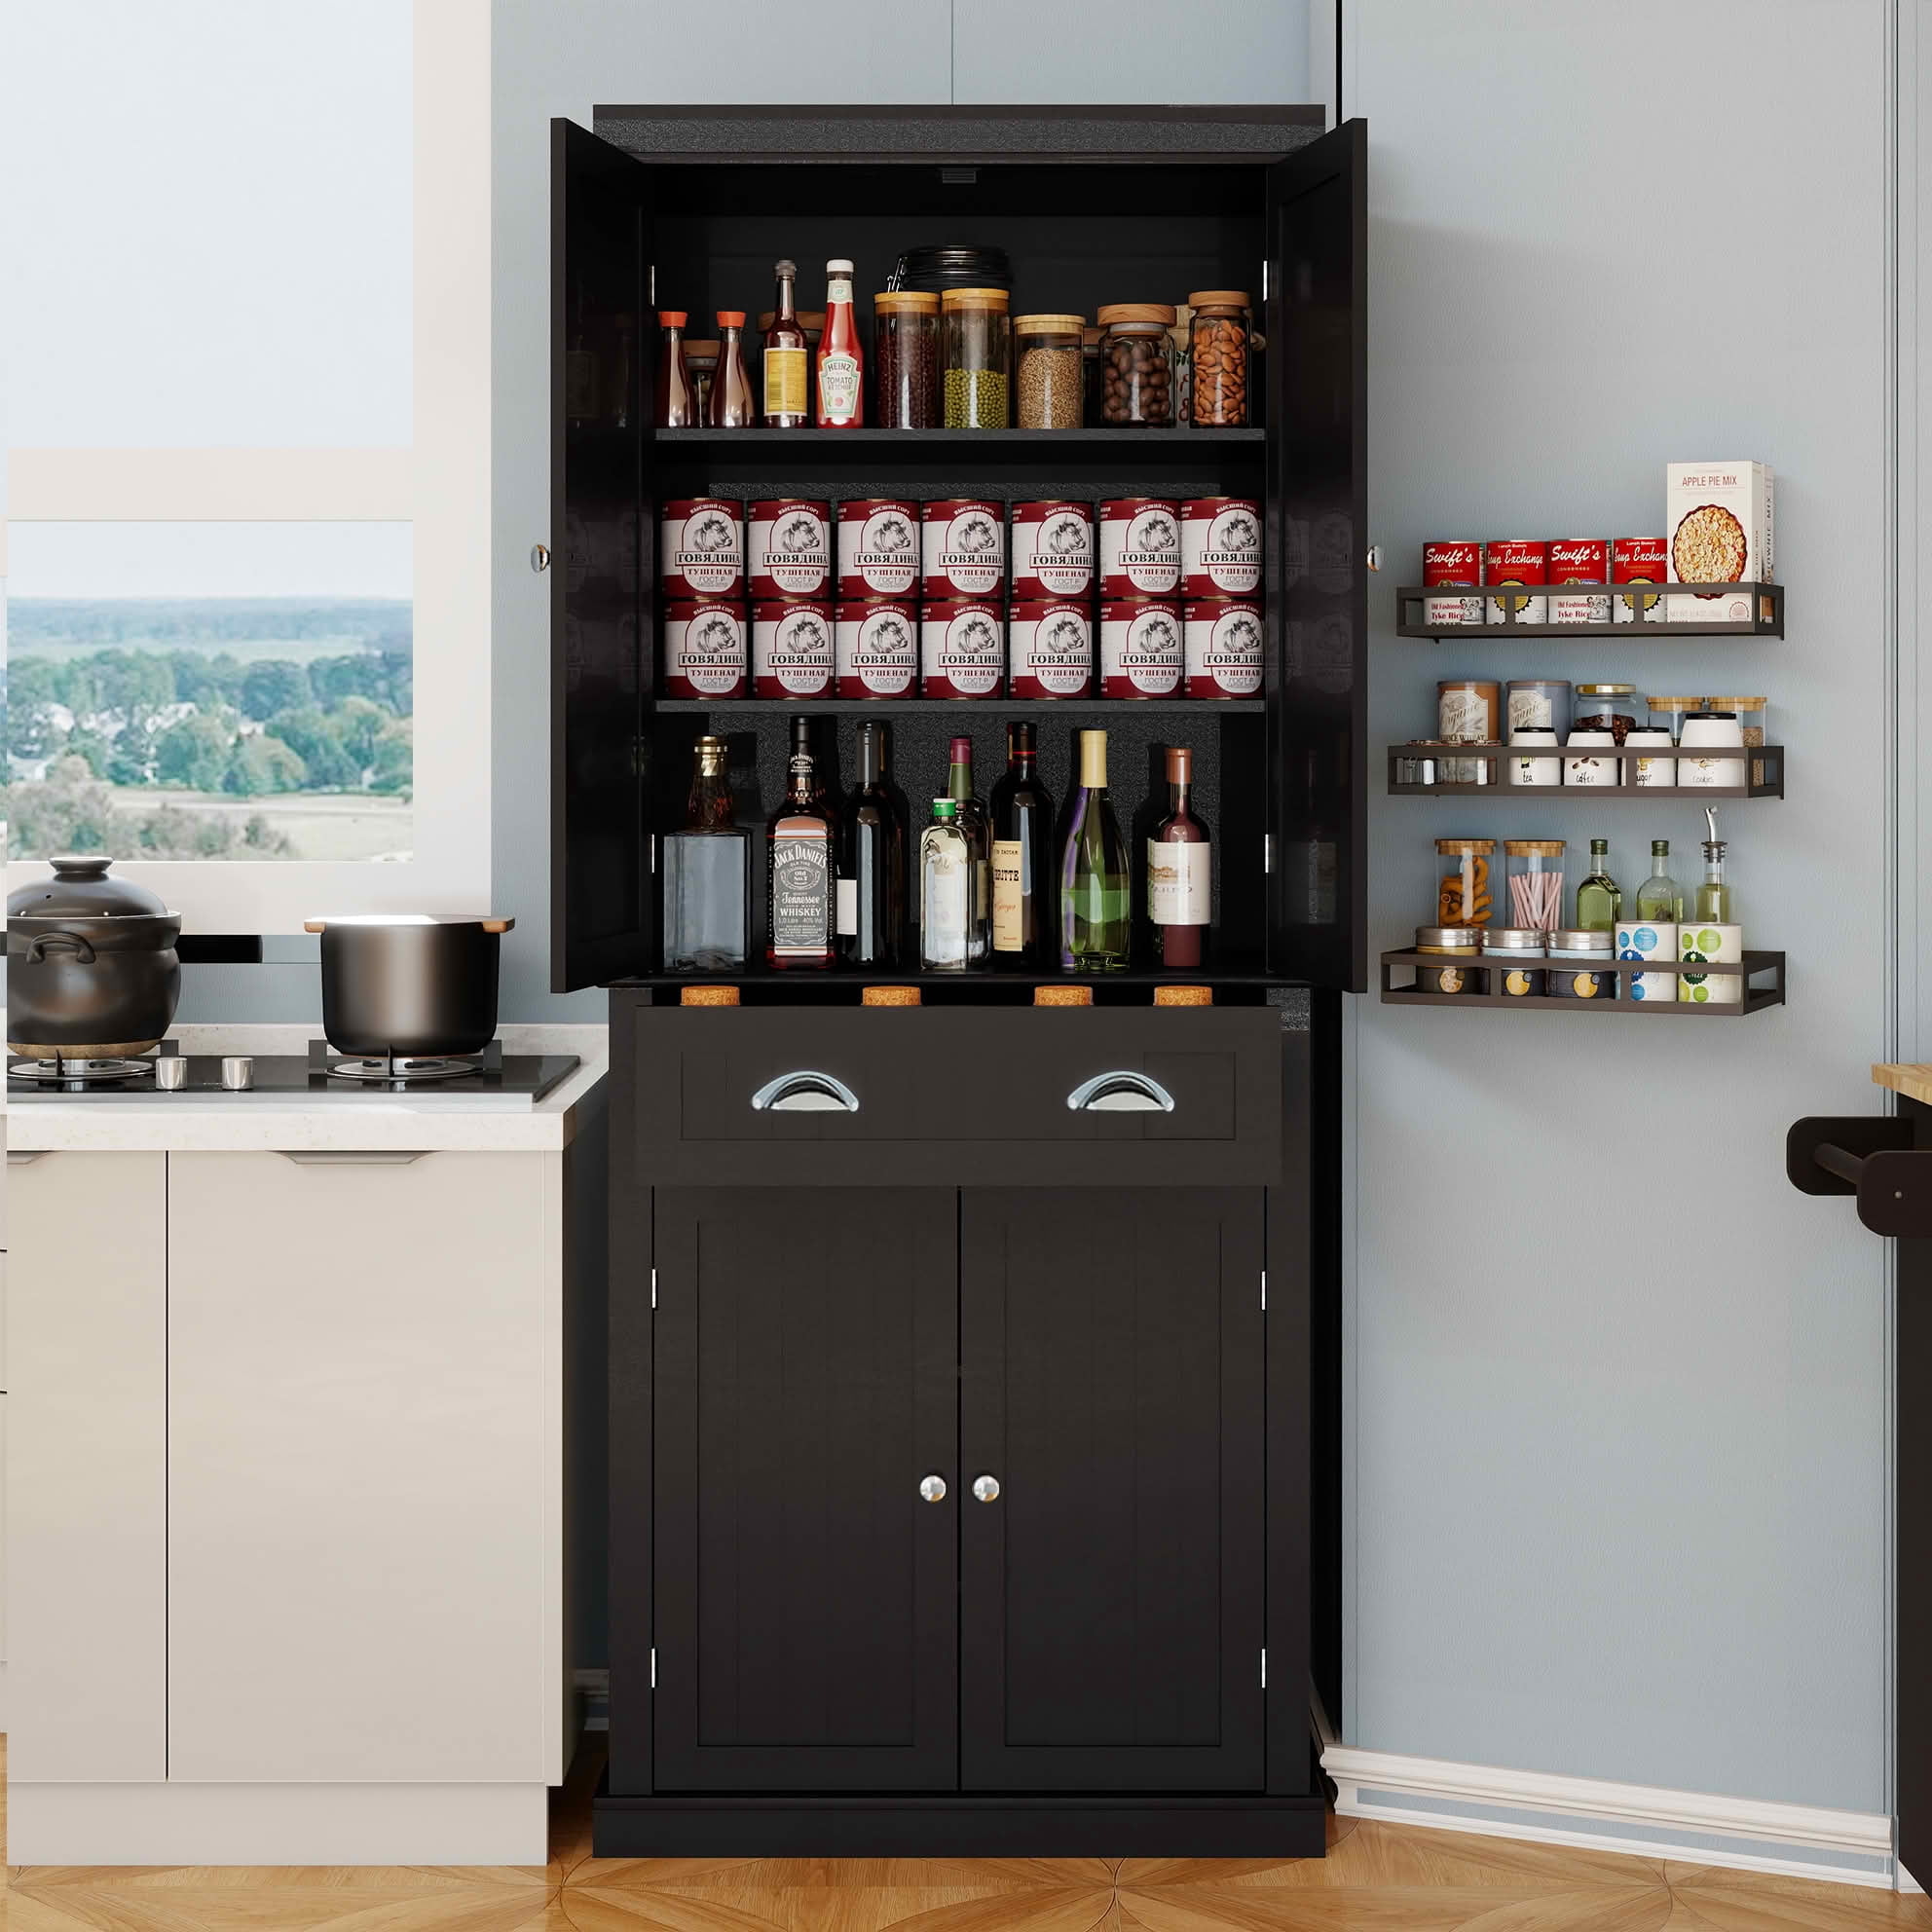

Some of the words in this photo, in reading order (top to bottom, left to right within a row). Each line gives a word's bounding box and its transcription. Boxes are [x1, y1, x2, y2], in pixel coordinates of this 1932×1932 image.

[828, 362, 851, 372] HEINZ
[1683, 477, 1706, 487] APPLE
[1708, 476, 1720, 486] PIE
[1722, 475, 1737, 485] MIX
[1426, 547, 1473, 567] Swift's
[1505, 548, 1542, 569] Exchange
[1551, 545, 1601, 565] Swift's
[1523, 771, 1533, 783] tea
[1636, 773, 1652, 786] ugar
[774, 849, 795, 869] JACK
[782, 892, 820, 904] Tennessee
[779, 908, 821, 916] WHISKEY
